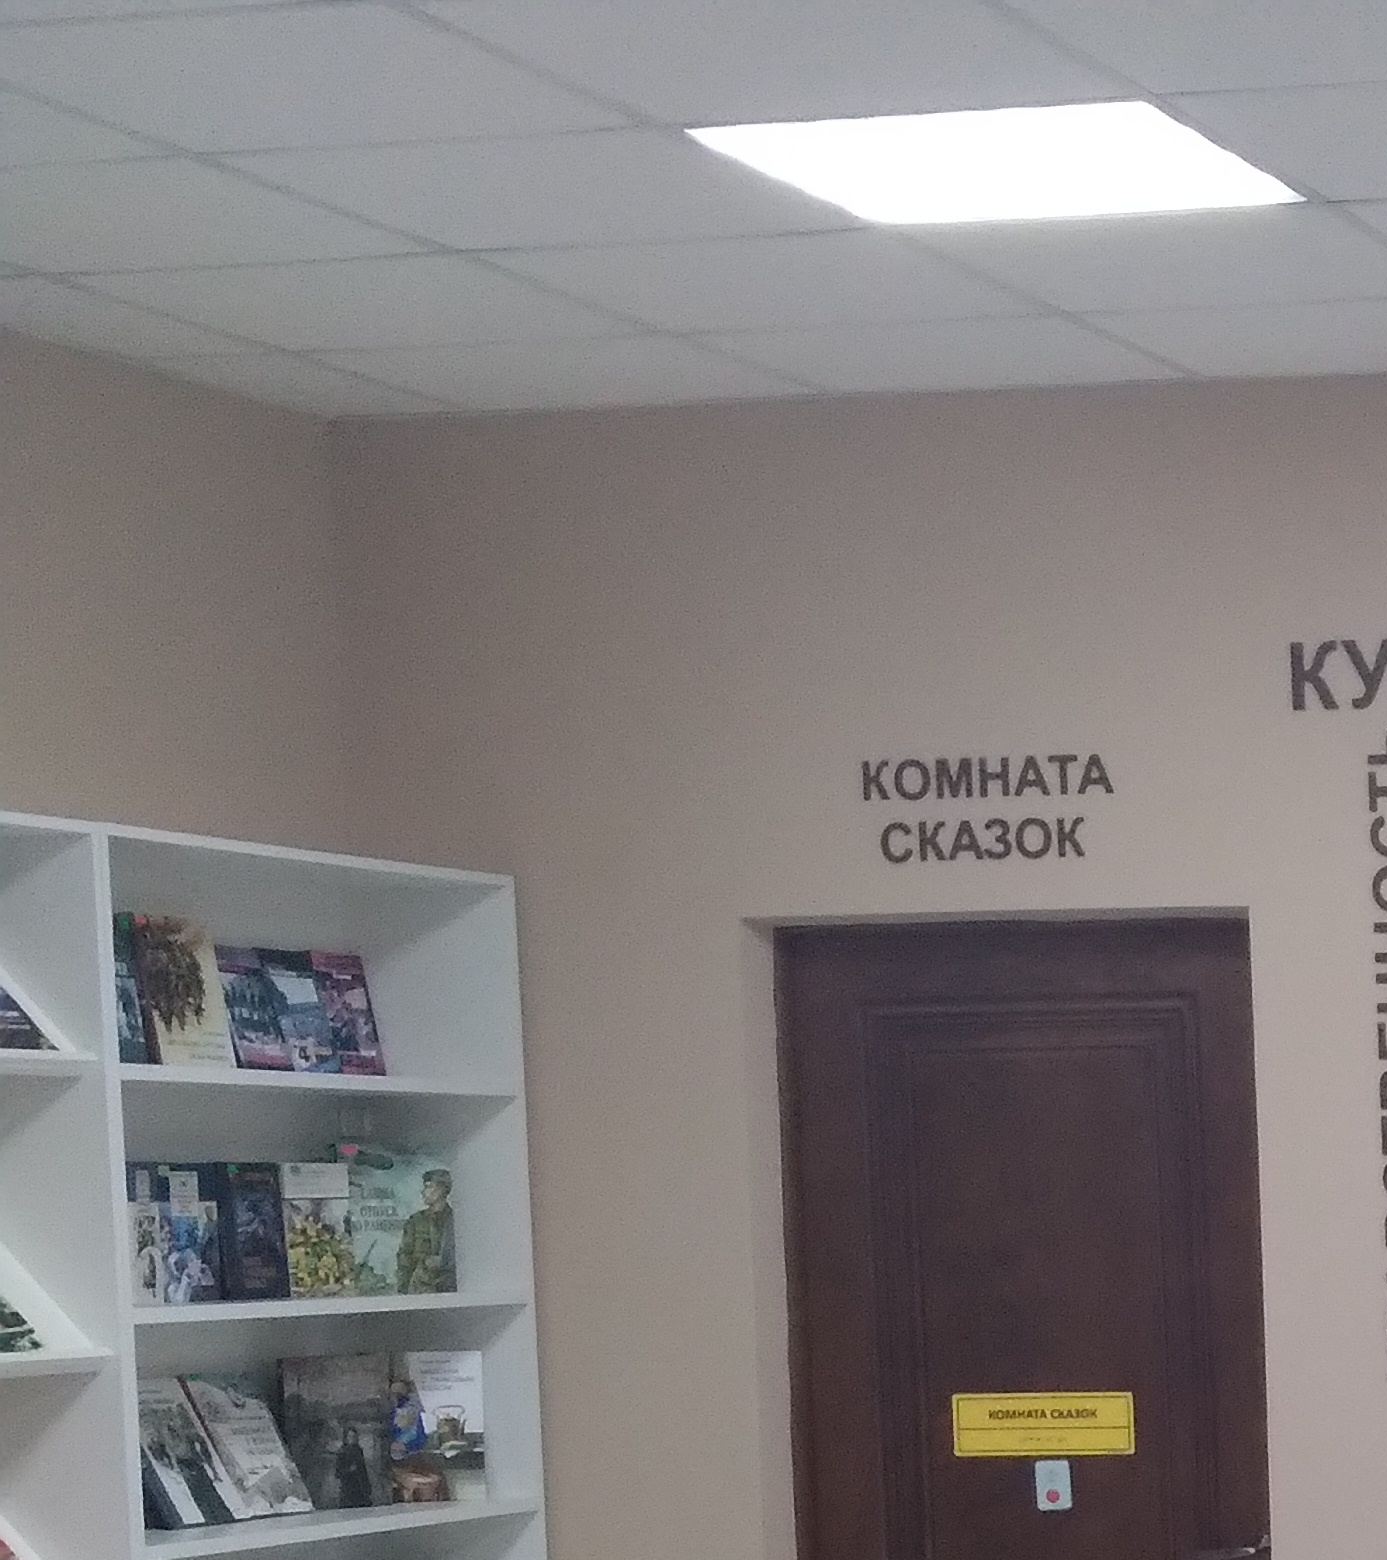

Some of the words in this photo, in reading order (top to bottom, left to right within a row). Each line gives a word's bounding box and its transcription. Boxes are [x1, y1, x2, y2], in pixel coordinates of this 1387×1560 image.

[861, 754, 1113, 801] КОМНАТА
[880, 817, 1084, 864] СКАЗОК
[988, 1408, 1048, 1421] КОМНАТА
[1050, 1407, 1098, 1420] СКАЗОК
